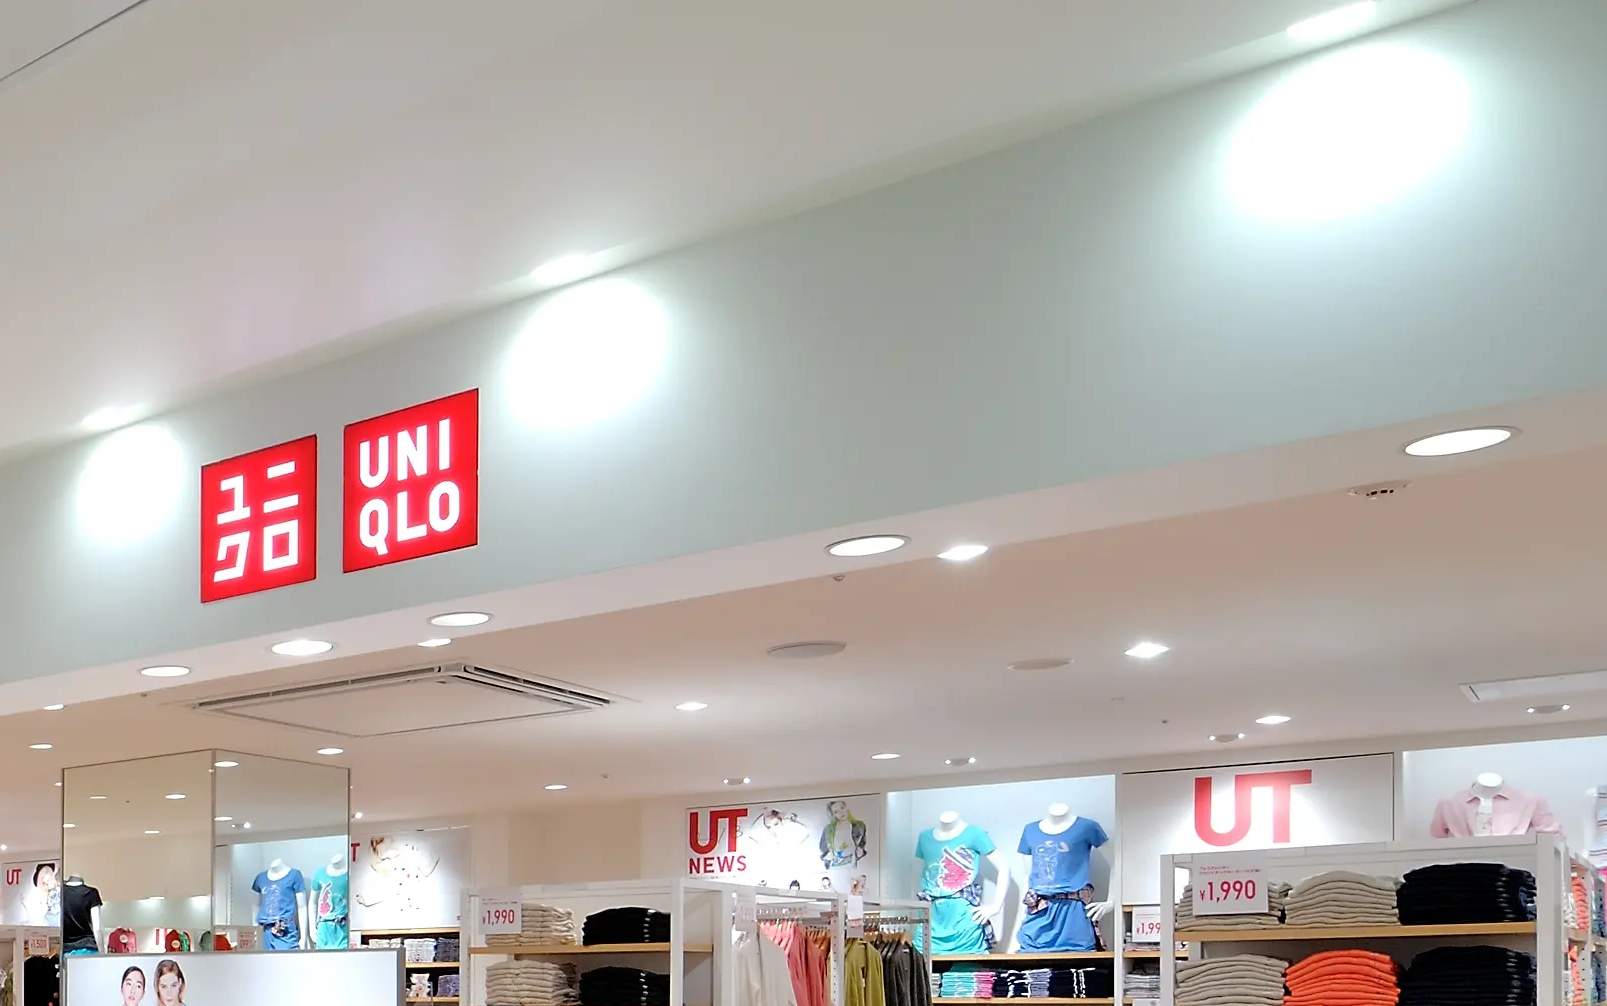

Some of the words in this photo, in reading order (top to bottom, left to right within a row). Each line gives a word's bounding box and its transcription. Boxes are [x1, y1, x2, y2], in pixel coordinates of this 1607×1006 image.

[358, 418, 450, 488] UNI
[216, 460, 299, 525] ユニ
[358, 480, 460, 556] QLO
[213, 519, 299, 583] クロ
[689, 808, 748, 855] UT
[1195, 769, 1312, 847] UT
[6, 868, 22, 886] UT
[689, 855, 747, 875] NEWS
[1199, 880, 1256, 903] ¥1,990
